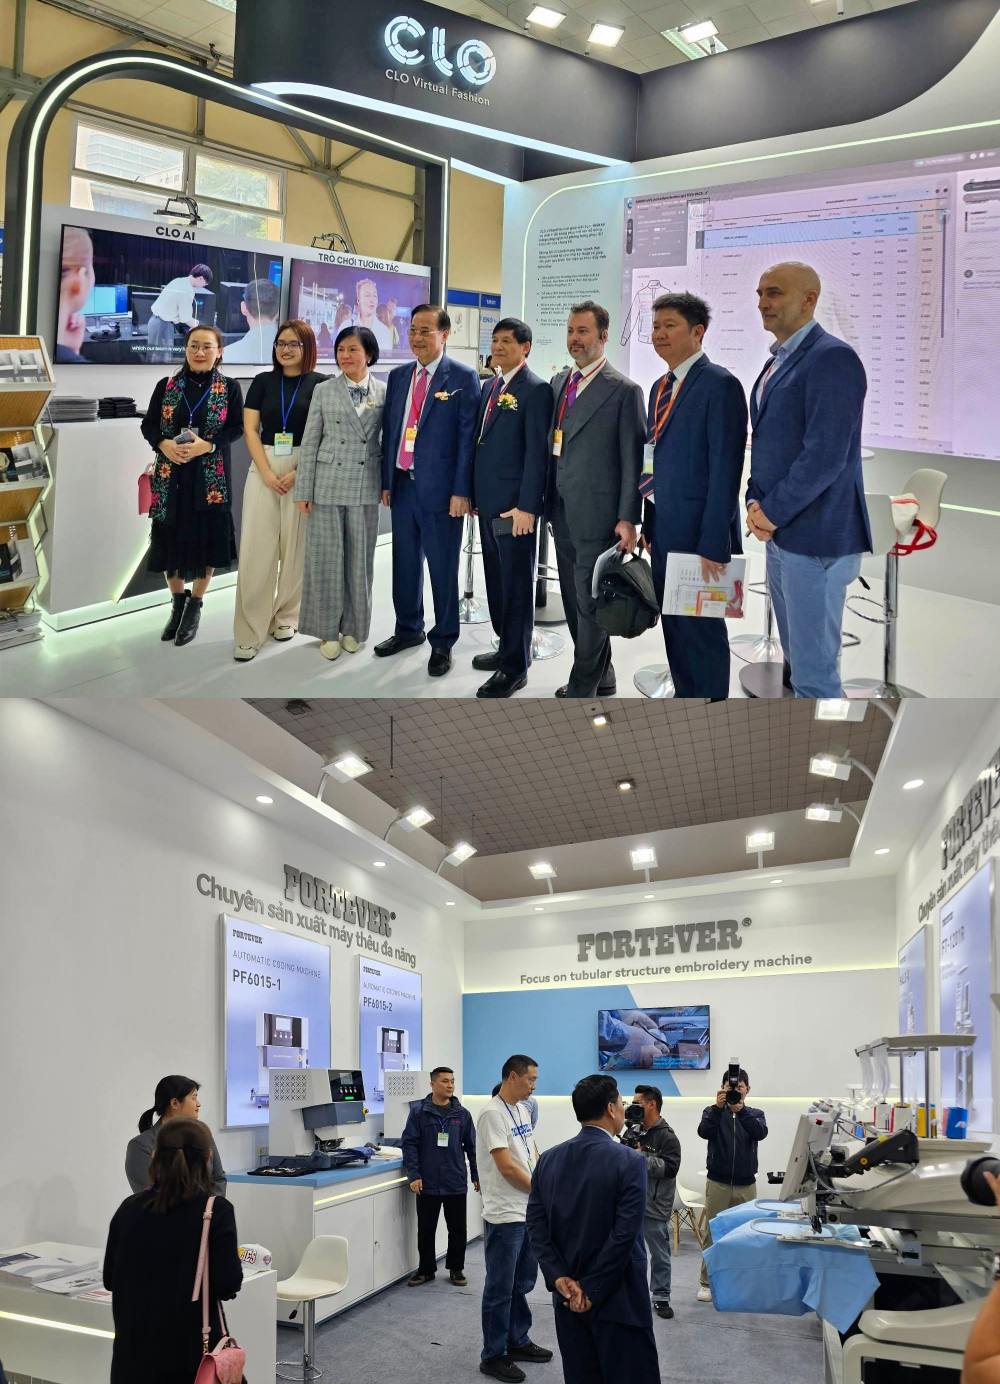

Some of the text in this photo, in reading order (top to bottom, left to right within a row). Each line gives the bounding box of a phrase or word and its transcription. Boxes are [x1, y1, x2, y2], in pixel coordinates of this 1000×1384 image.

[384, 15, 497, 86] CLO
[385, 68, 490, 106] CLO Virtual Fashion
[155, 226, 196, 241] CLO AI
[318, 252, 400, 272] TRÒ CHƠI TƯƠNG TÁC
[196, 873, 417, 969] Chuyên sản xuất máy thêu đa năng
[232, 929, 263, 944] FORTEVER
[232, 950, 321, 979] AUTOMATIC CODING MACHINE
[520, 952, 813, 985] Focus on tubular structure embroidery machine
[232, 968, 281, 991] PF6015-1
[363, 996, 393, 1012] PF6015-2
